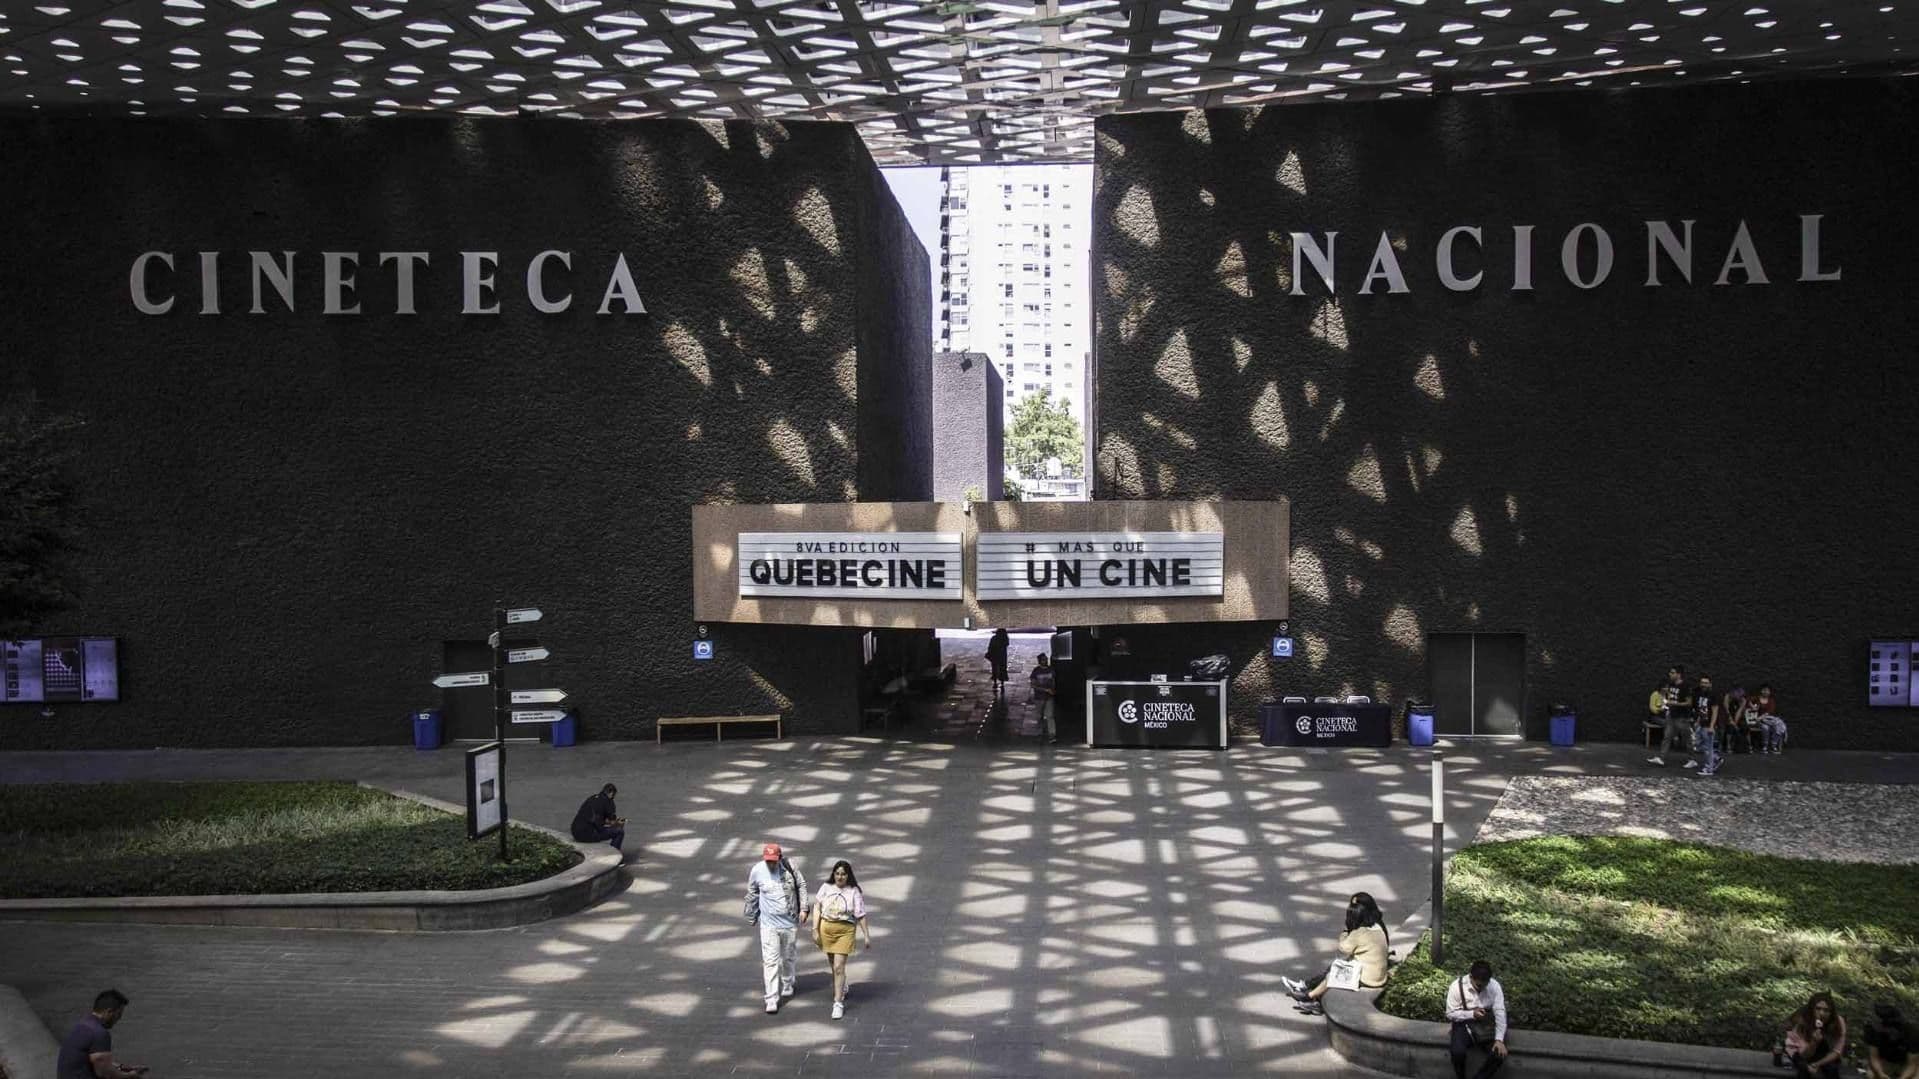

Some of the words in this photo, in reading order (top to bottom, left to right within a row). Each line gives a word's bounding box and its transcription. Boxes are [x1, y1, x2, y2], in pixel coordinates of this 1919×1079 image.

[129, 250, 648, 316] CINETECA
[1288, 214, 1842, 295] NACIONAL
[796, 542, 823, 553] 8VA
[829, 542, 900, 553] EDICION
[1059, 542, 1094, 553] MAS
[1113, 541, 1145, 552] QUE
[750, 559, 946, 588] QUEBECINE
[1027, 559, 1081, 588] UN
[1100, 558, 1190, 587] CINE
[1143, 703, 1195, 712] CINETECA
[1143, 712, 1195, 721] NACIONAL
[1316, 717, 1357, 725] CINETECA
[1316, 724, 1358, 732] NACIONAL
